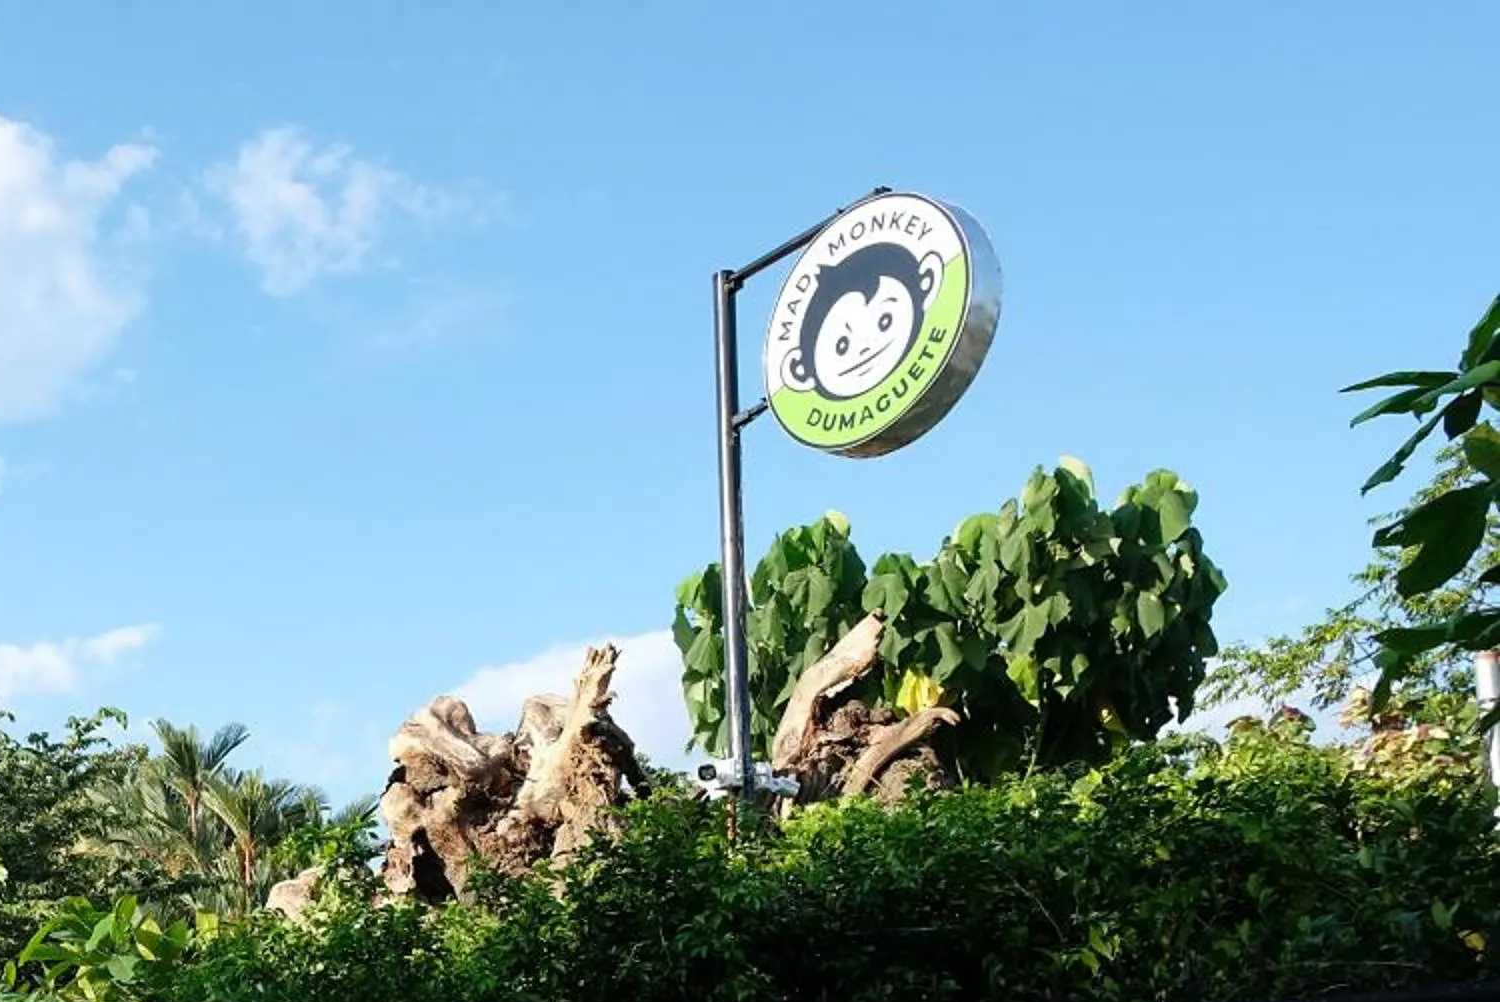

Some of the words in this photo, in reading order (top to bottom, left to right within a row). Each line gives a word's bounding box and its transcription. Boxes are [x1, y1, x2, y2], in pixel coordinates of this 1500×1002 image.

[778, 273, 812, 341] MAD
[827, 210, 934, 257] MONKEY
[806, 327, 947, 432] DUMAGUETE
